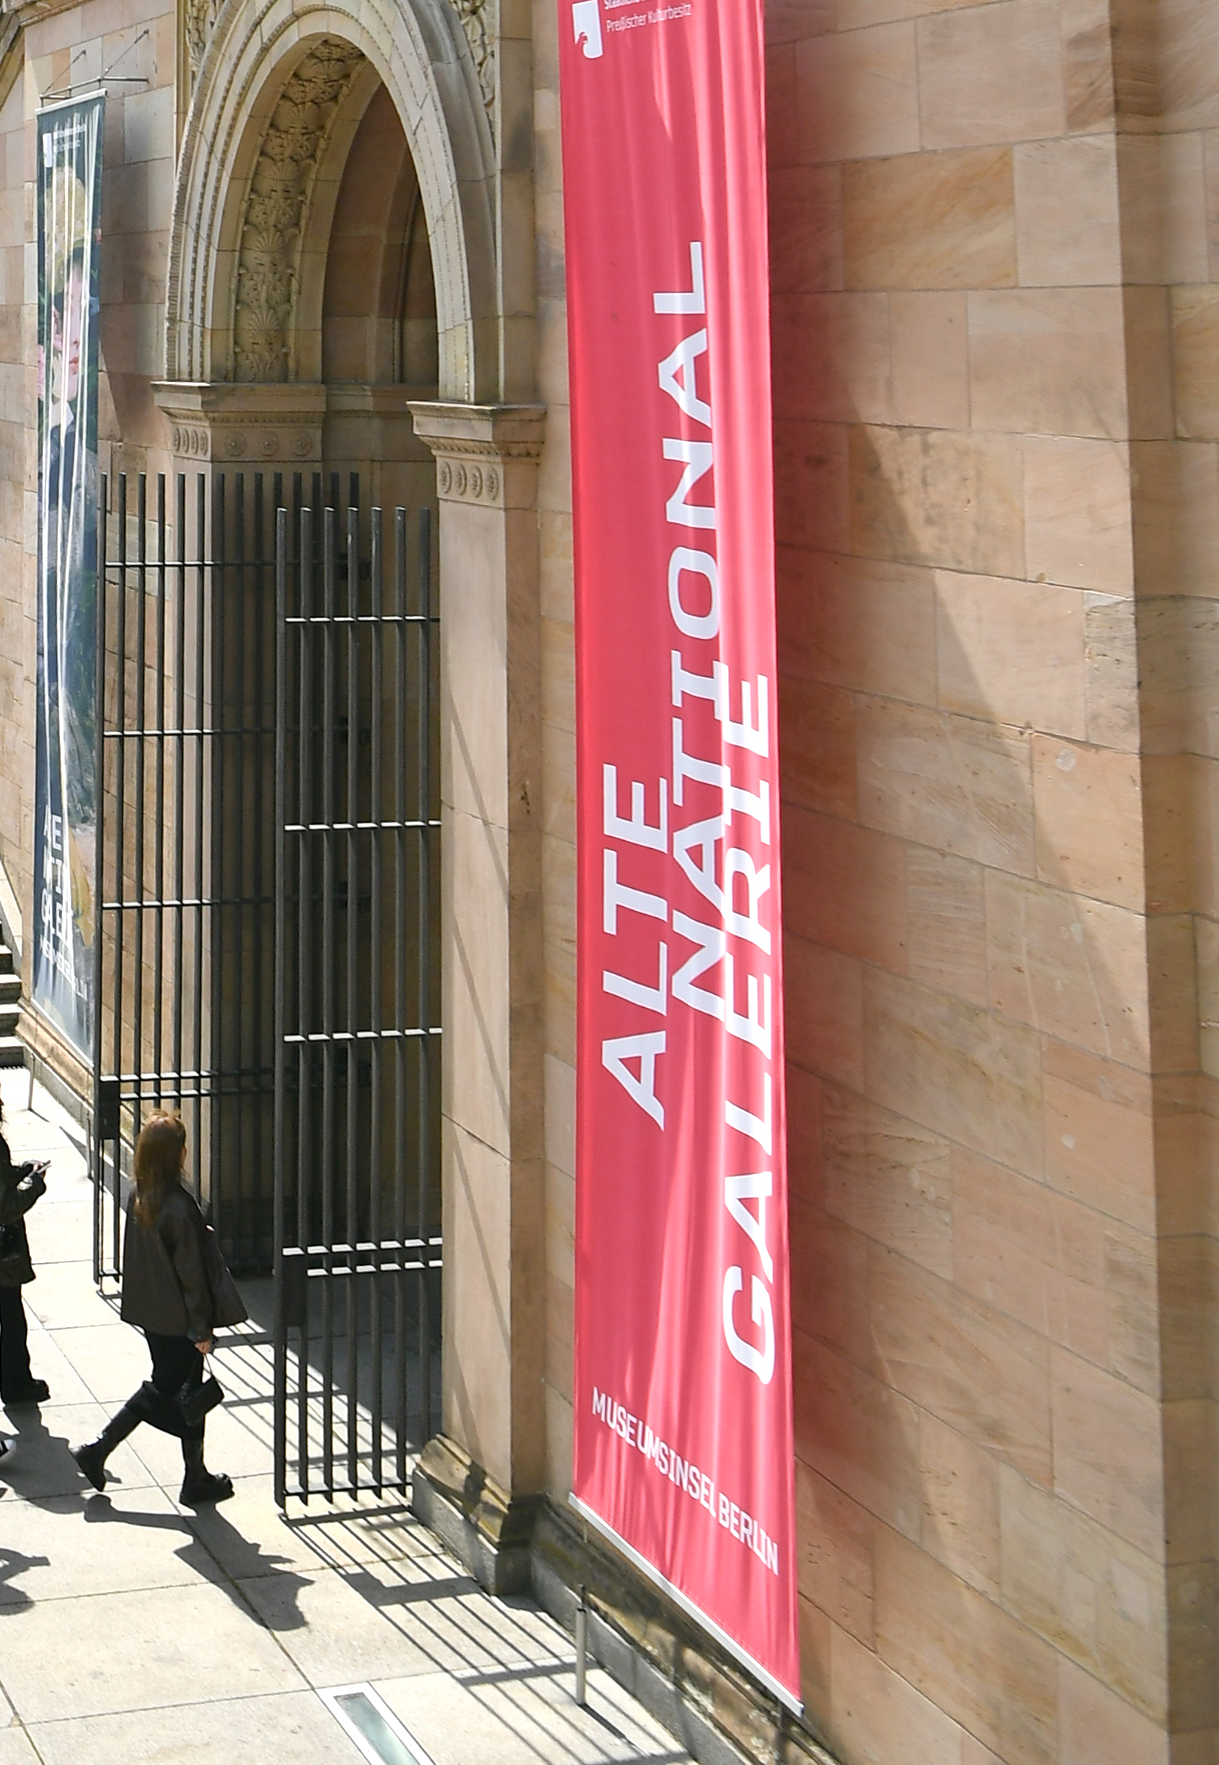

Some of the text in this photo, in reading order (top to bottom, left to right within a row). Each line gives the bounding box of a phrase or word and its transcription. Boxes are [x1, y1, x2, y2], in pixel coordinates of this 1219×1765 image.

[653, 241, 726, 1024] NATIONAL
[602, 763, 668, 1131] ALTE
[719, 662, 776, 1385] GALERIE
[592, 1386, 778, 1576] MUSEUMSINSEL BERLIN
